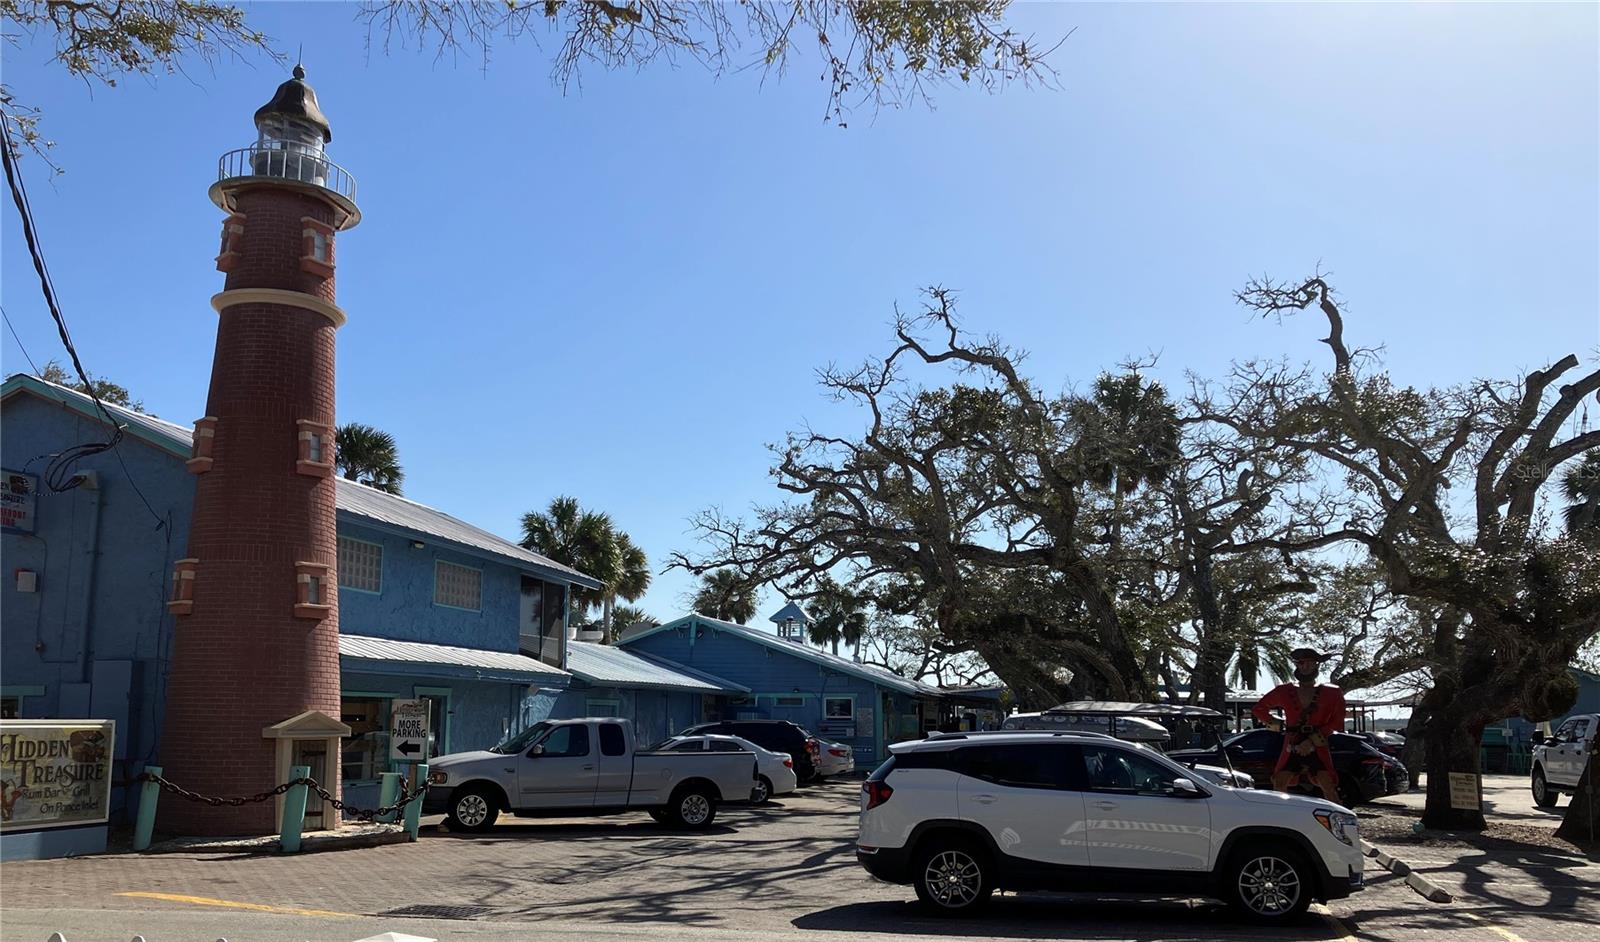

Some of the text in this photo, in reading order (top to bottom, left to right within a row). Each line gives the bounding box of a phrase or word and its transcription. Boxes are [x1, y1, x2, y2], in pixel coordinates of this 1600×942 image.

[399, 720, 421, 729] MORE
[392, 729, 426, 738] PARKING
[0, 734, 70, 763] HIDDEN
[14, 760, 104, 788] TREASURE
[23, 789, 43, 800] Rum
[44, 787, 60, 798] Bar
[73, 782, 91, 797] Grill
[40, 803, 54, 814] On
[55, 801, 80, 813] Ponce
